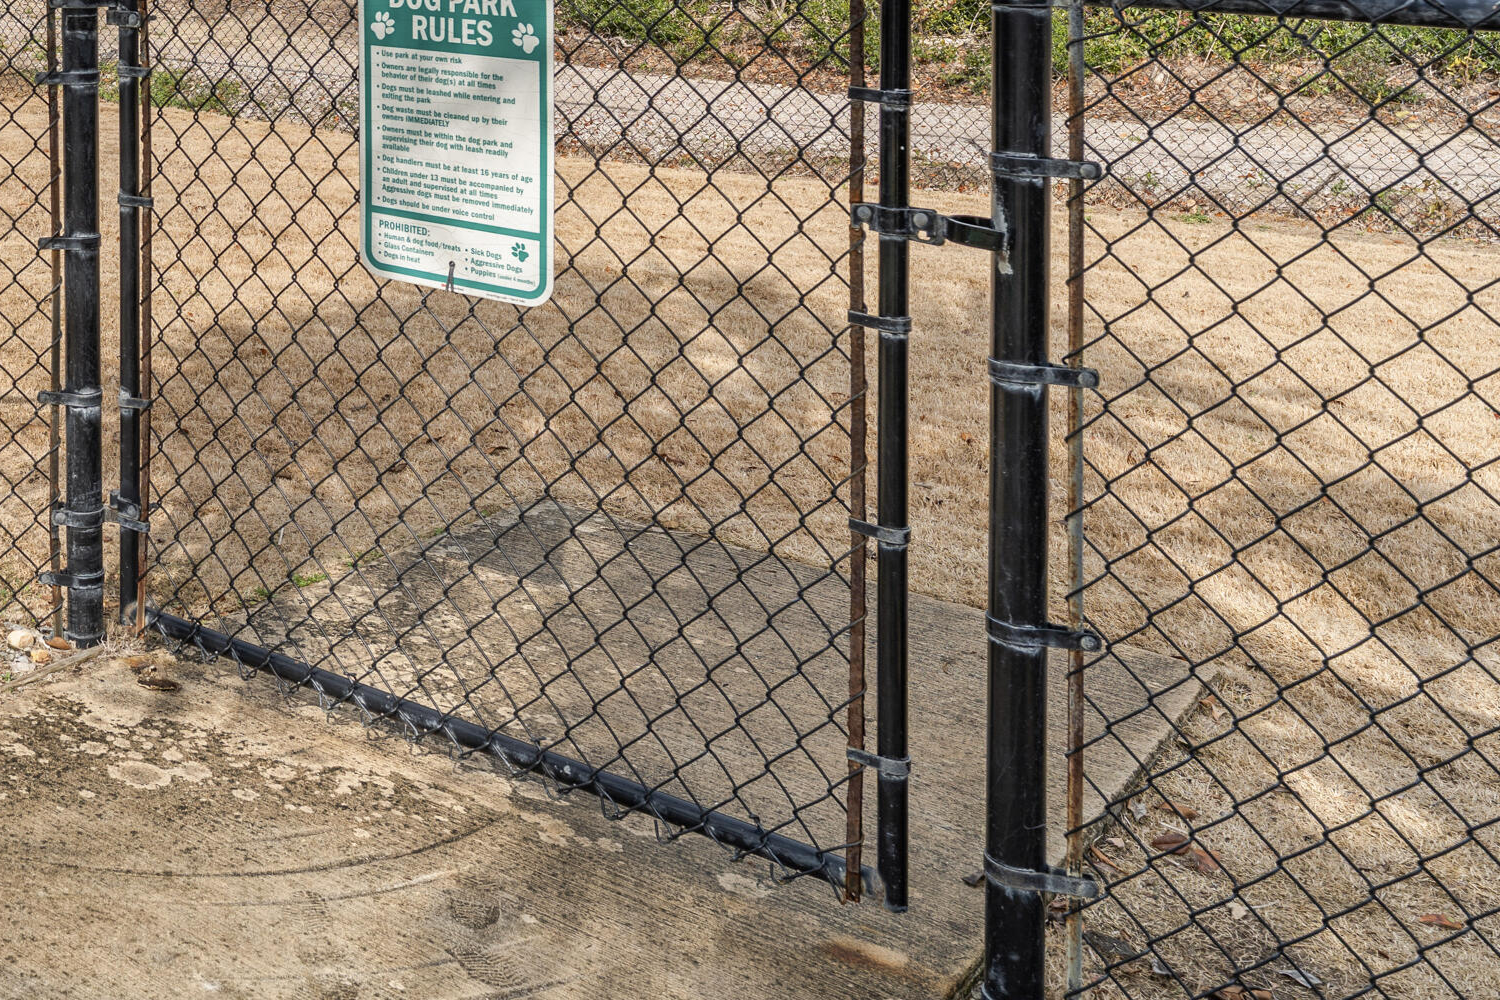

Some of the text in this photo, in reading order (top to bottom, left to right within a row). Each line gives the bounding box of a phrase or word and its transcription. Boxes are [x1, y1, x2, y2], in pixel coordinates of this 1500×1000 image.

[412, 15, 493, 47] RULES
[418, 66, 438, 75] legally
[441, 70, 478, 78] responsible
[435, 77, 456, 86] dog(s)
[477, 81, 495, 89] times
[381, 84, 396, 92] Dogs
[426, 89, 451, 97] leashed
[472, 94, 500, 104] entering
[382, 93, 402, 101] exiting
[382, 105, 394, 113] Dog
[405, 116, 449, 127] IMMEDIATELY
[382, 126, 404, 134] Owners
[468, 137, 480, 145] dog
[382, 135, 417, 145] supervising
[436, 141, 447, 149] dog
[465, 145, 483, 153] leash
[485, 149, 508, 157] readily
[382, 144, 409, 152] available
[382, 155, 394, 164] Dog
[395, 157, 423, 166] handlers
[461, 166, 477, 174] least
[382, 168, 407, 176] Children
[469, 181, 513, 192] accompanied
[516, 187, 523, 195] by
[423, 183, 457, 193] supervised
[479, 191, 497, 199] times
[382, 185, 415, 195] Aggressive
[417, 190, 431, 198] dogs
[462, 198, 489, 206] removed
[492, 201, 533, 215] immediately
[382, 197, 397, 205] Dogs
[399, 200, 419, 208] should
[470, 212, 494, 220] control
[379, 219, 430, 236] PROHIBITED:
[383, 233, 404, 241] Human
[412, 238, 423, 246] dog
[425, 240, 460, 251] food/treats
[384, 242, 434, 256] Glass Containers
[383, 251, 398, 259] Dogs
[406, 255, 420, 263] heat
[470, 248, 501, 260] Sick Dogs
[470, 258, 522, 273] Aggressive Dogs
[470, 267, 495, 277] Puppies
